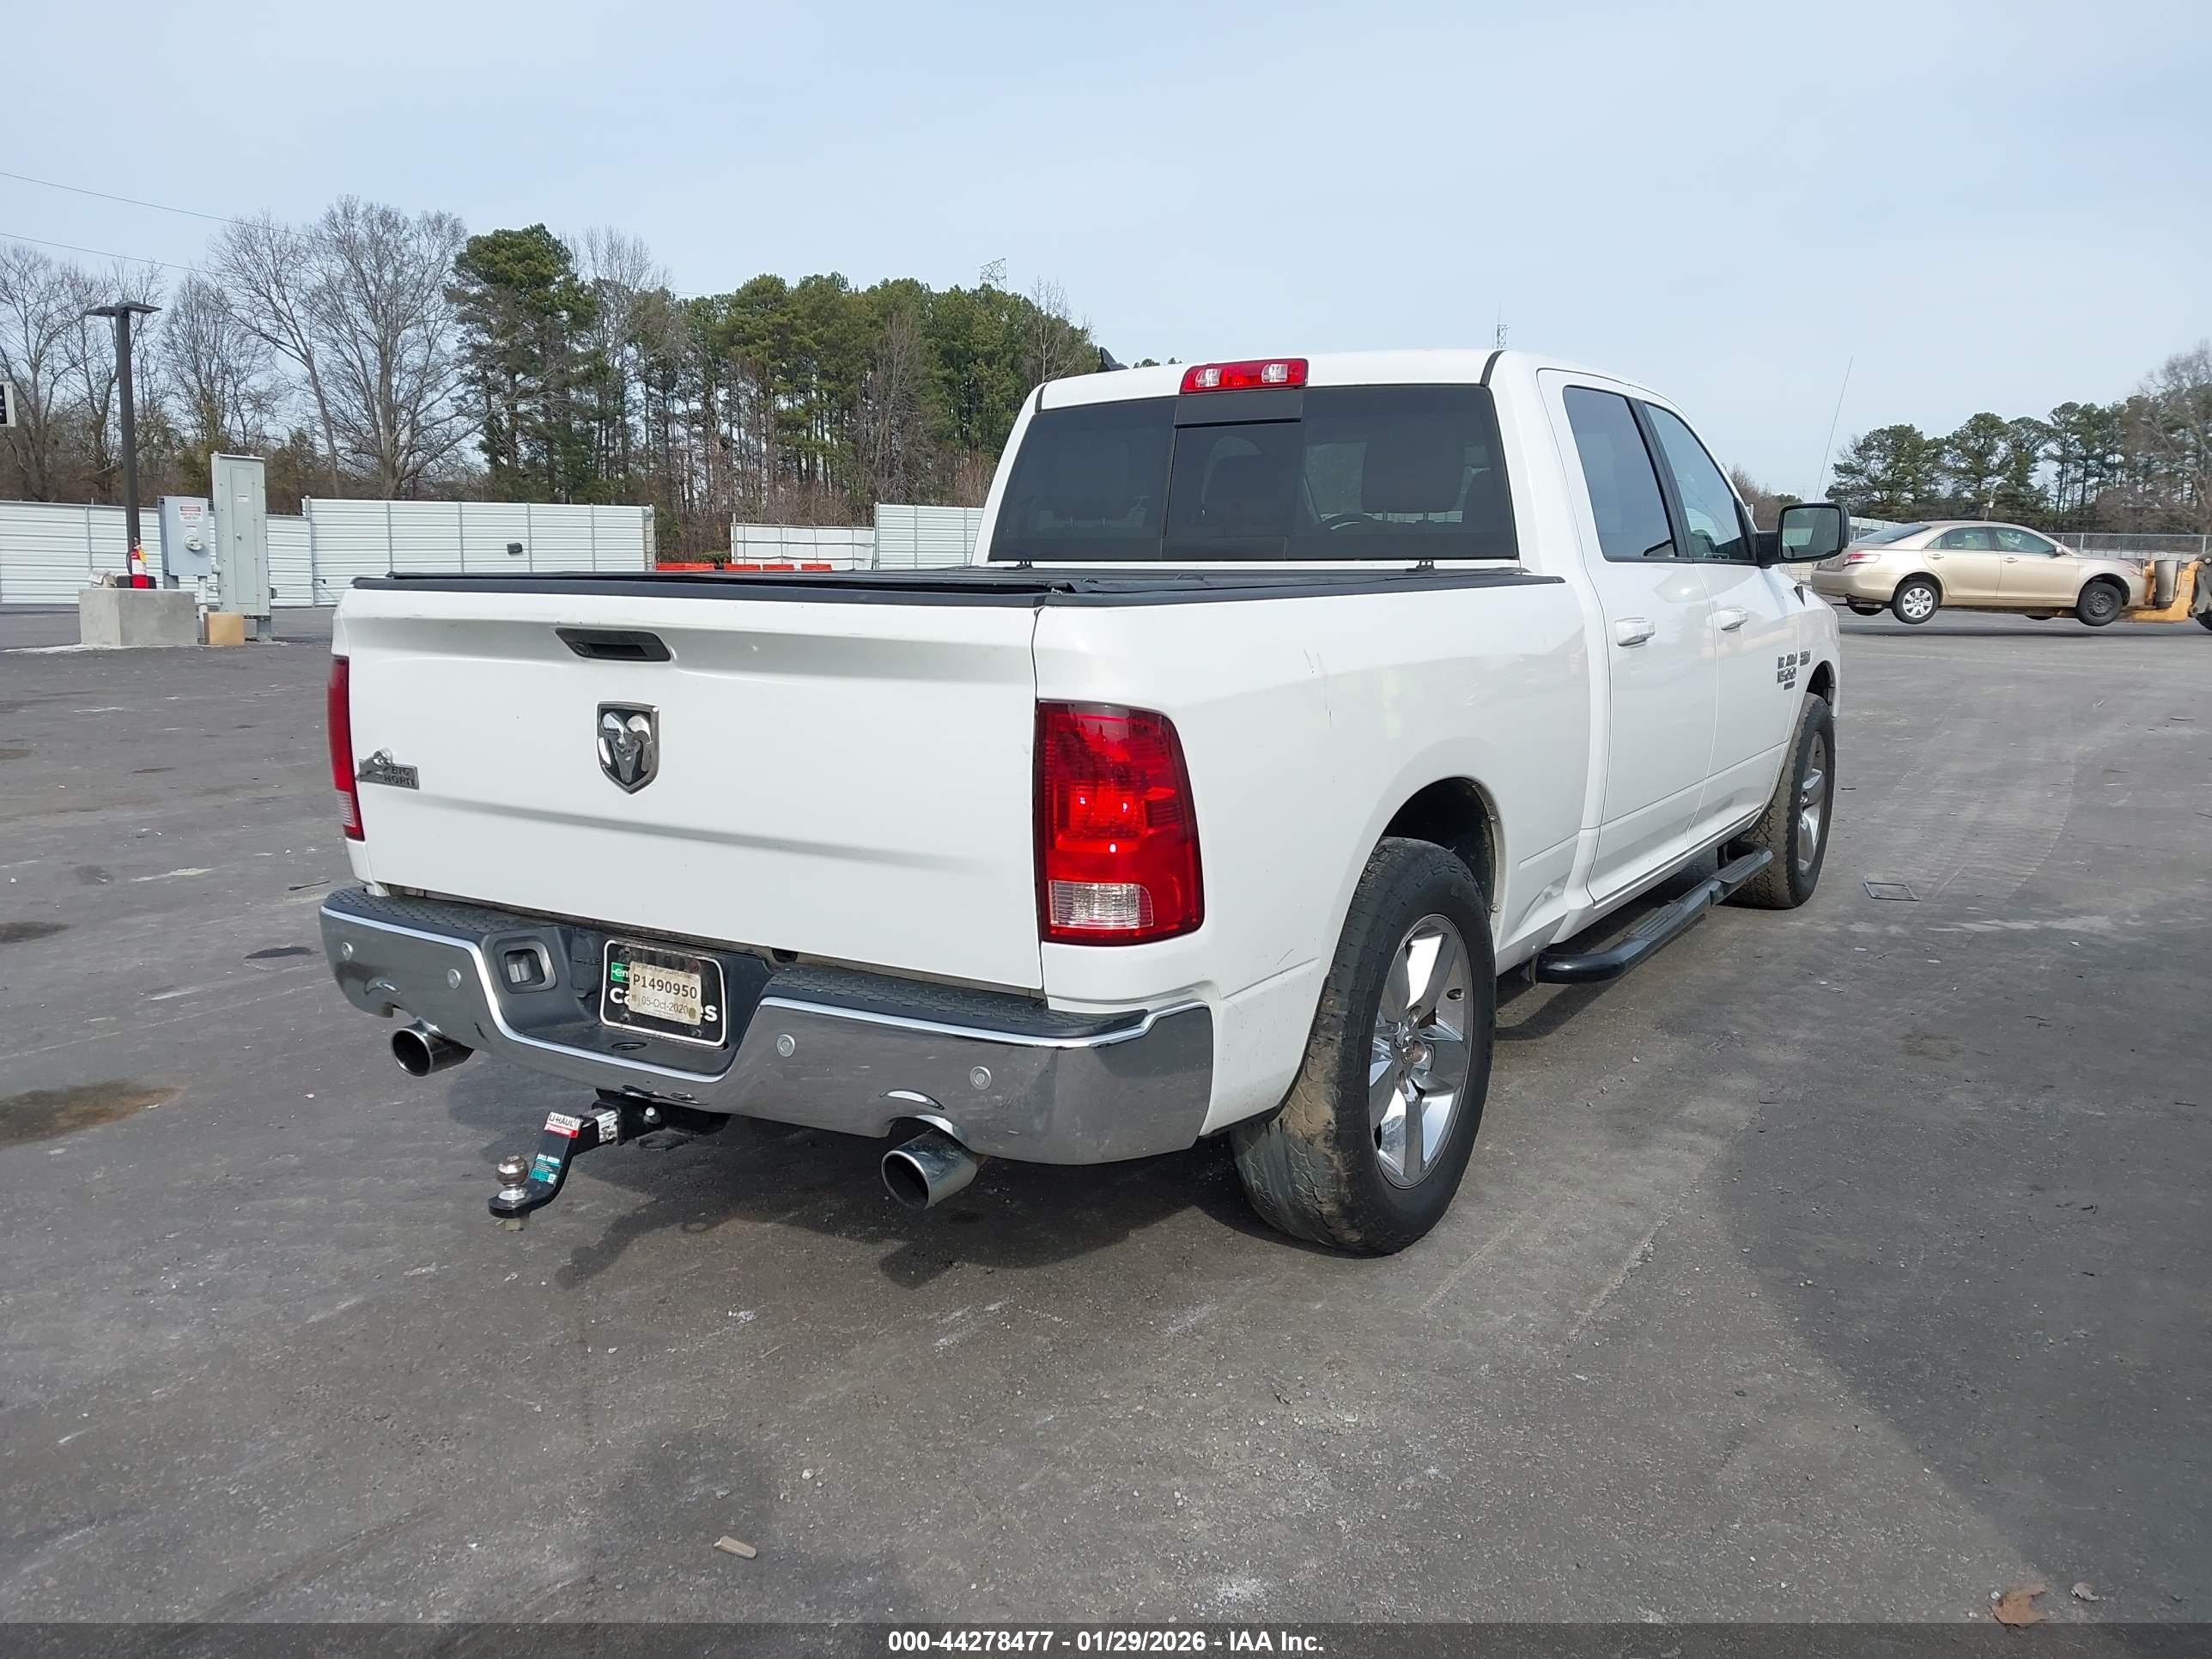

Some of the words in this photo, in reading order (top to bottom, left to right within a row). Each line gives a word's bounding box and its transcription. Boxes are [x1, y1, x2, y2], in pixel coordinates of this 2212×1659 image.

[392, 765, 410, 776] BIG
[384, 775, 415, 787] HORN
[633, 974, 697, 1000] P1490950
